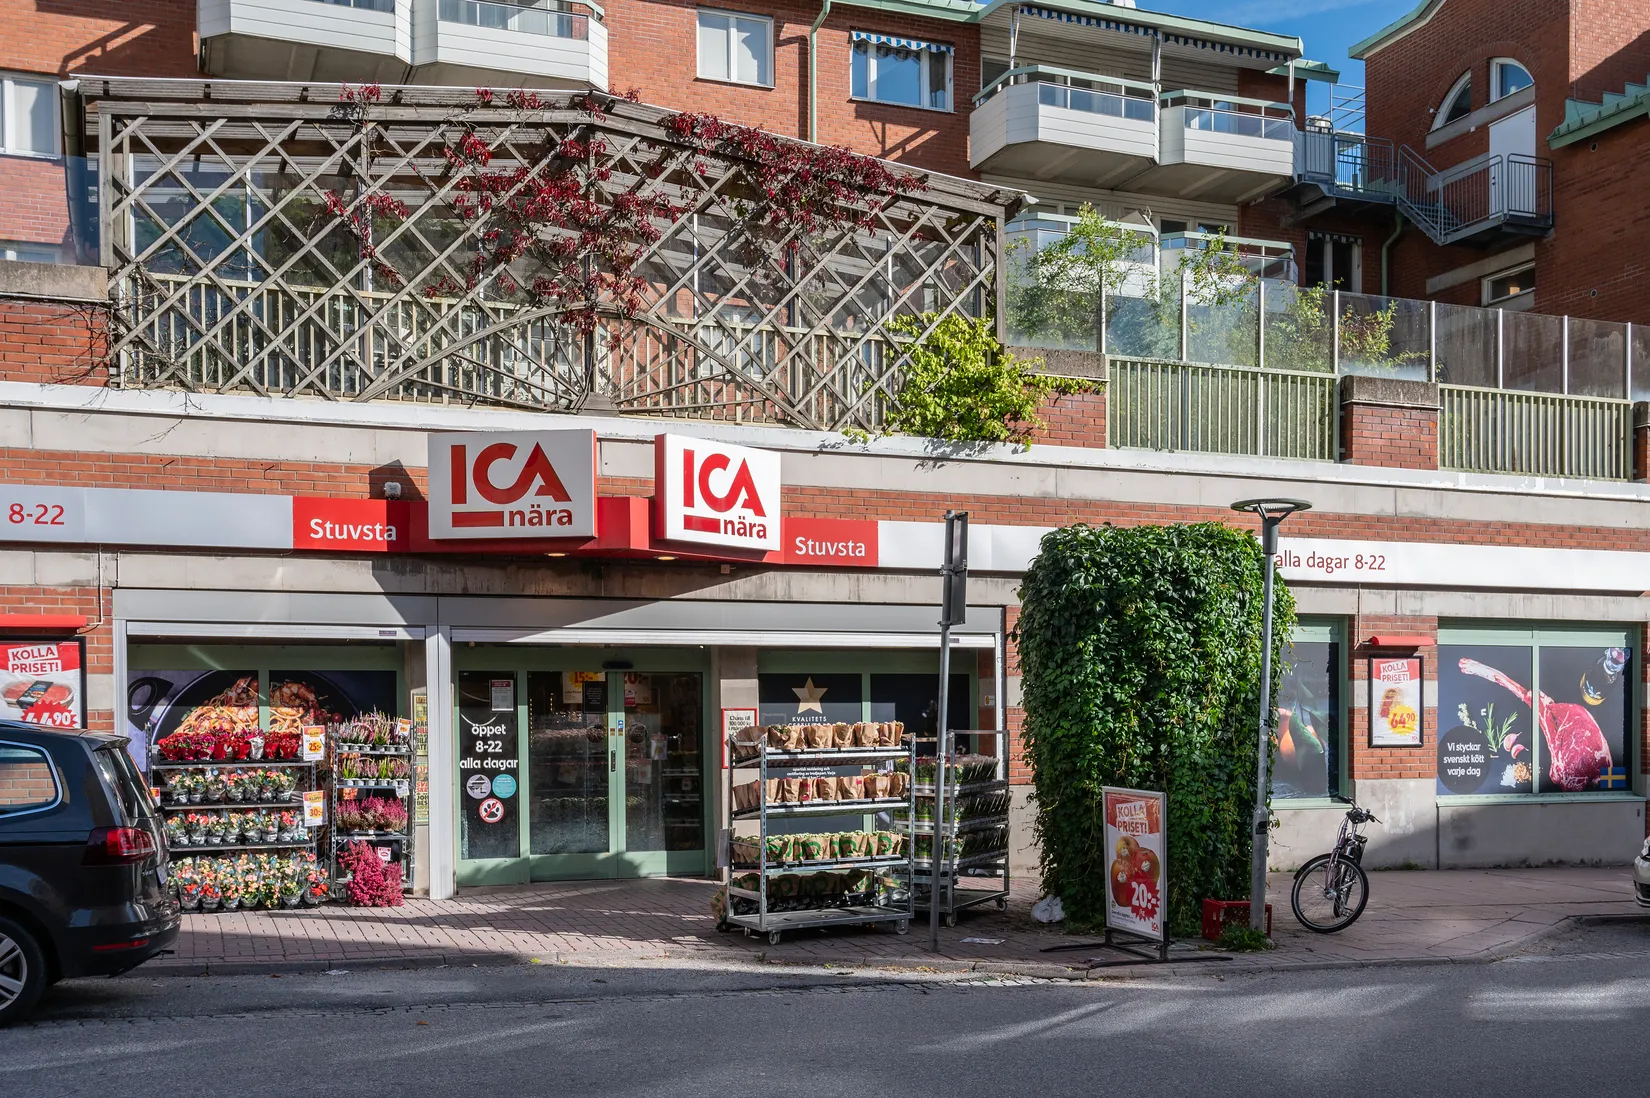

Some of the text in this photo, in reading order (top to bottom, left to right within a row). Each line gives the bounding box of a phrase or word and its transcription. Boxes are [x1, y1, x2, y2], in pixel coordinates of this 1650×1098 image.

[451, 441, 572, 505] ICA
[683, 448, 767, 517] ICA
[9, 503, 65, 525] 8-22
[508, 504, 572, 526] nära
[310, 518, 397, 541] Stuvsta
[723, 515, 767, 539] nära
[795, 536, 866, 557] Stuvsta
[1275, 550, 1386, 574] alla dagar 8-22
[11, 646, 56, 660] KOLLA
[11, 662, 59, 673] PRISET!
[1382, 662, 1407, 673] KOLLA
[1382, 673, 1409, 682] PRISET!
[471, 724, 506, 737] öppet
[475, 741, 503, 753] 8-22
[1447, 742, 1481, 753] Vi styckar
[459, 757, 518, 771] alla dagar
[1443, 754, 1485, 763] svenskt kött
[1447, 766, 1481, 777] varje dag
[1117, 804, 1145, 818] KOLLA
[1117, 821, 1147, 834] PRISET!
[1131, 881, 1157, 909] 20:-
